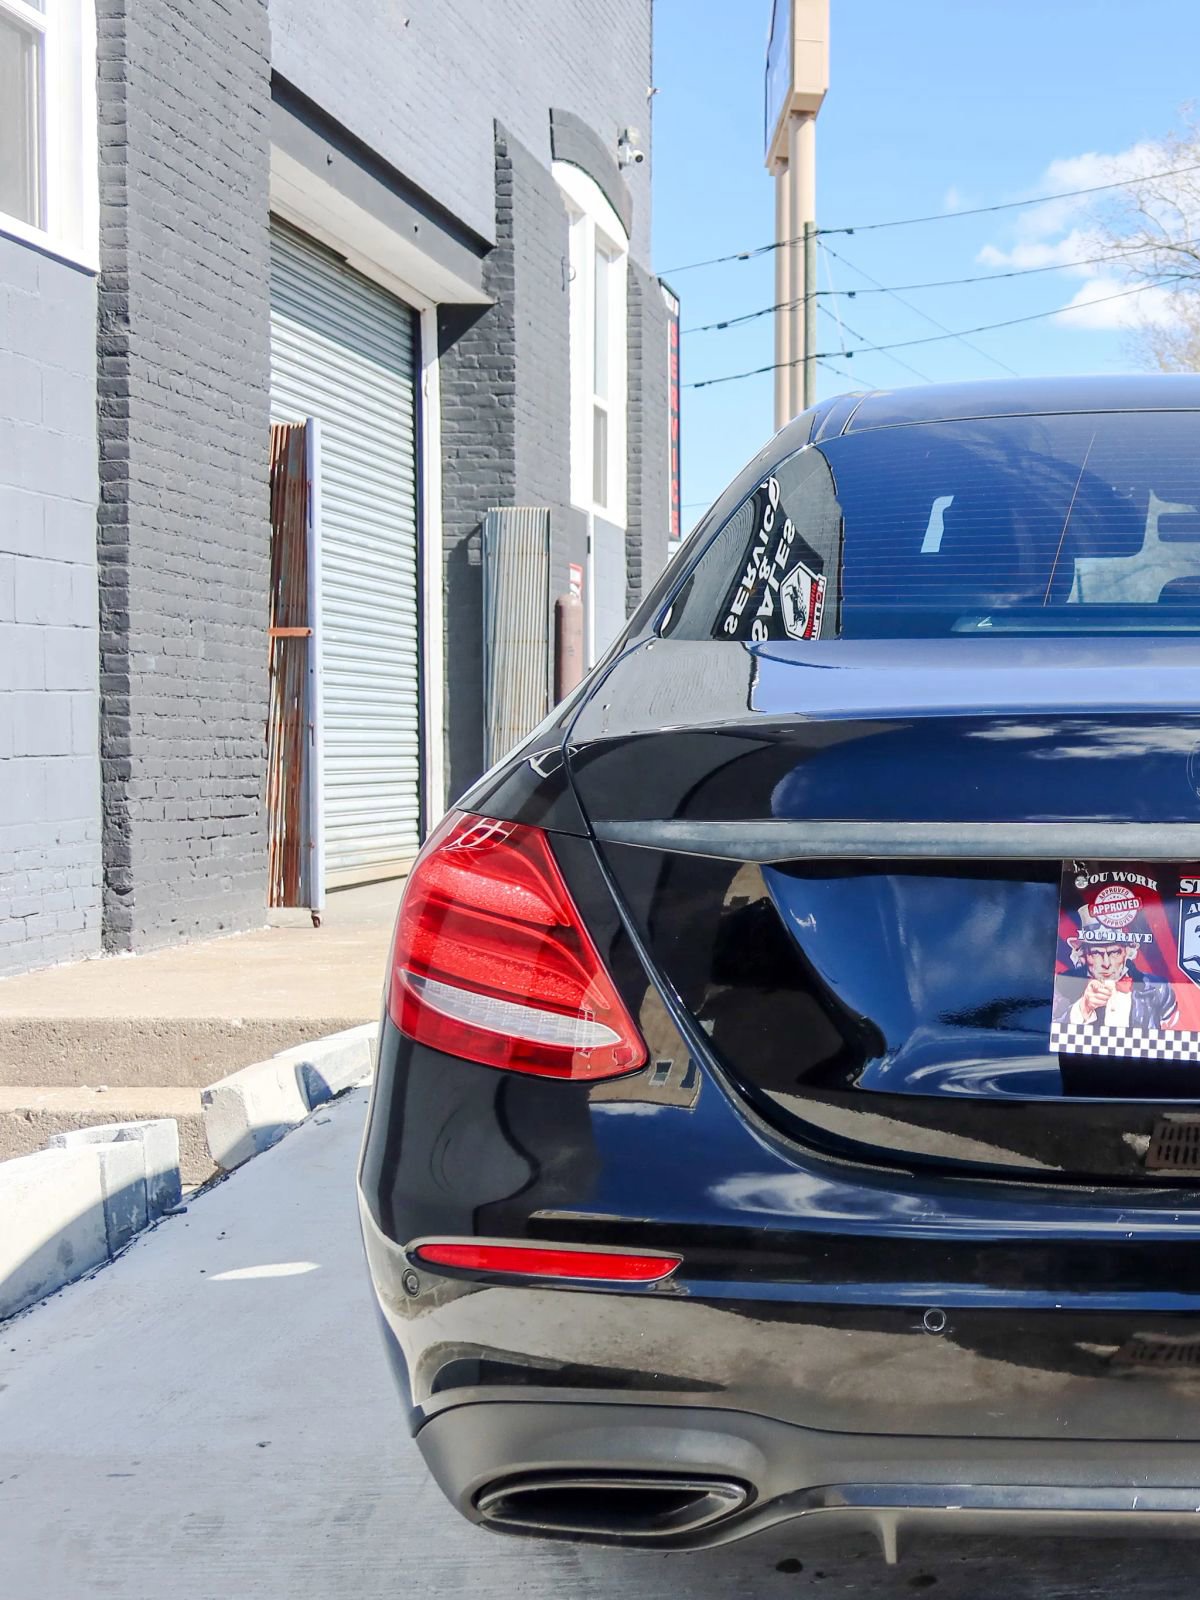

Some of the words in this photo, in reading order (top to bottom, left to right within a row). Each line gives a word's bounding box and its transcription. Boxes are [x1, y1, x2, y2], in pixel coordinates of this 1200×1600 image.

[670, 323, 679, 537] SERVICE
[1112, 871, 1157, 891] WORK
[1099, 886, 1130, 899] APPROVED
[1093, 900, 1140, 914] APPROVED
[1077, 929, 1105, 940] YOU
[1106, 931, 1153, 943] DRIVE
